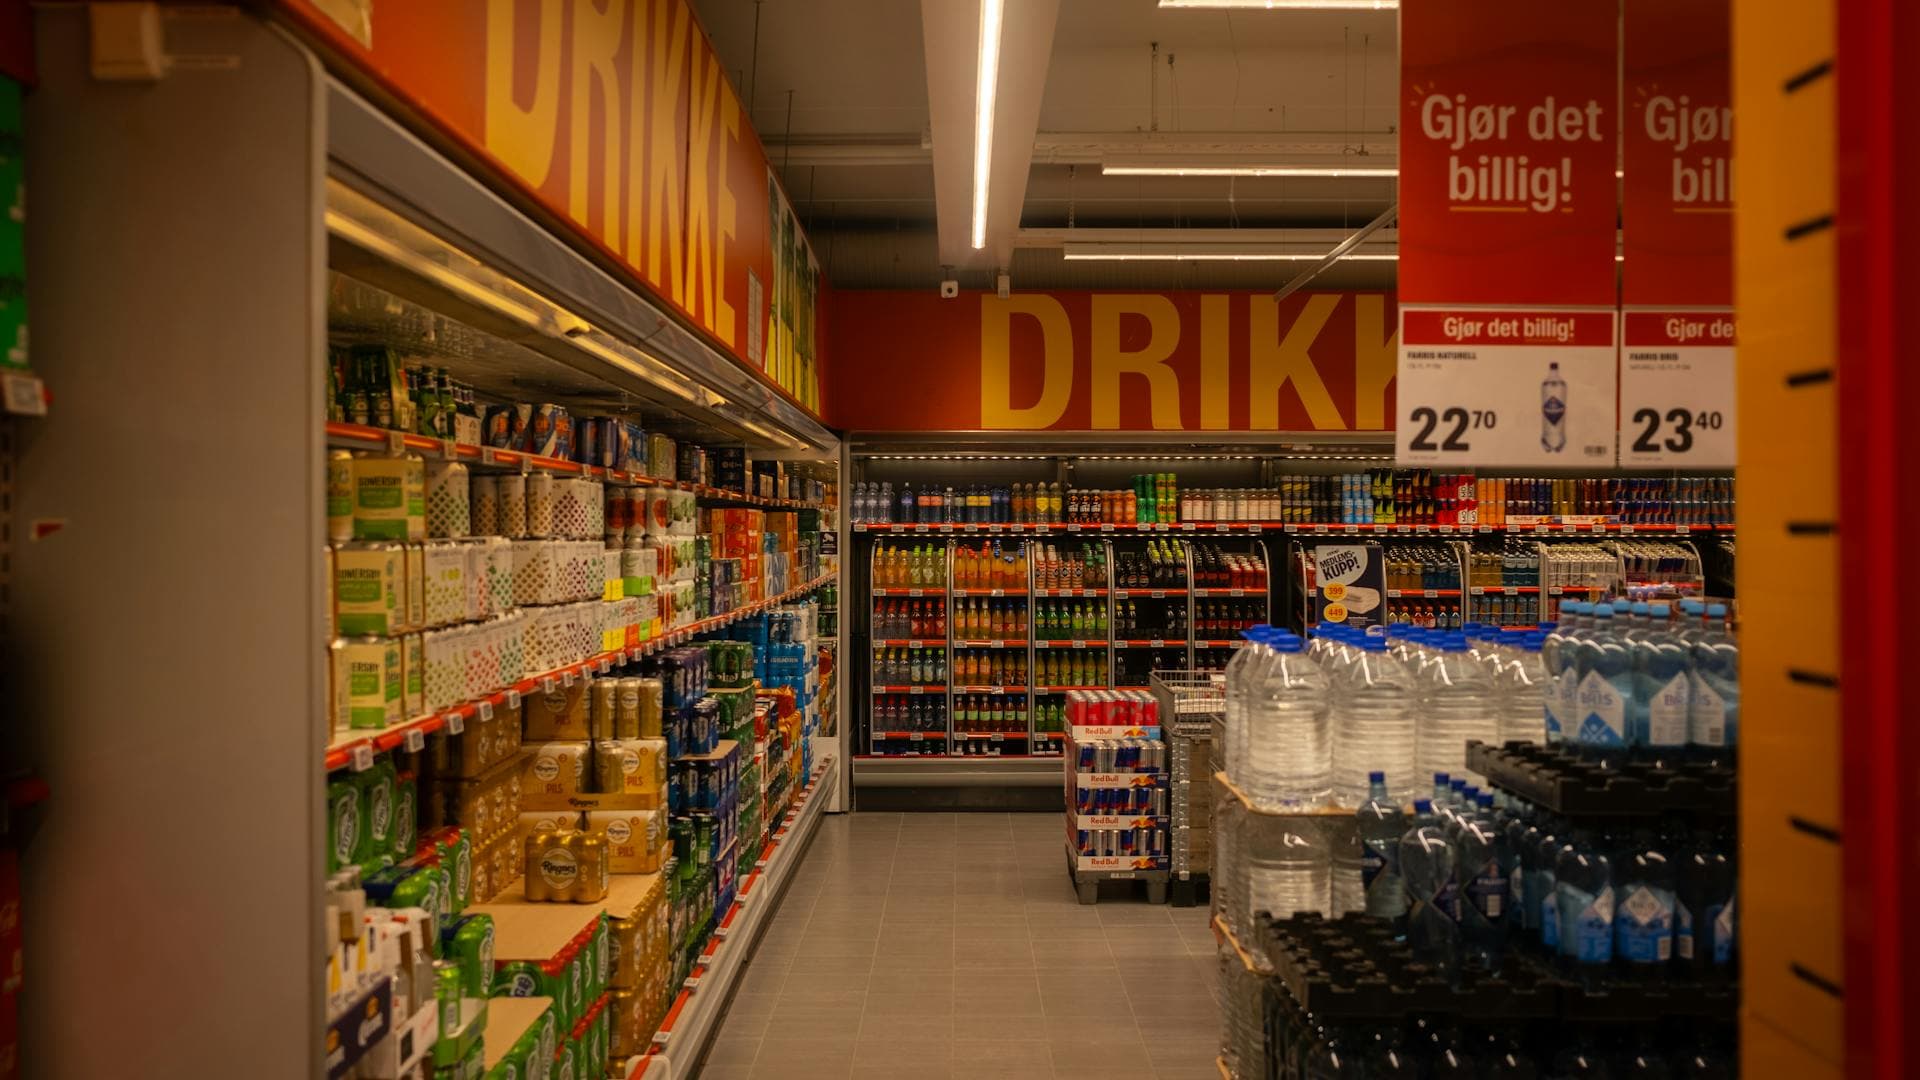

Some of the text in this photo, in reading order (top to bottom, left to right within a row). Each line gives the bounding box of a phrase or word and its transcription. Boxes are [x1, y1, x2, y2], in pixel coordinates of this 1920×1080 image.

[1420, 93, 1603, 150] Gjør det
[1449, 155, 1573, 212] billig!
[1443, 317, 1575, 342] Gjør det billig!
[1666, 318, 1706, 342] Gjør
[1409, 407, 1496, 452] 22 70
[1632, 408, 1723, 453] 23 40
[1323, 556, 1360, 581] KUPP!
[1085, 727, 1112, 735] Red Bull
[1090, 817, 1119, 825] Red Bull
[542, 860, 577, 875] Ringnes
[1091, 858, 1119, 866] Red Bull
